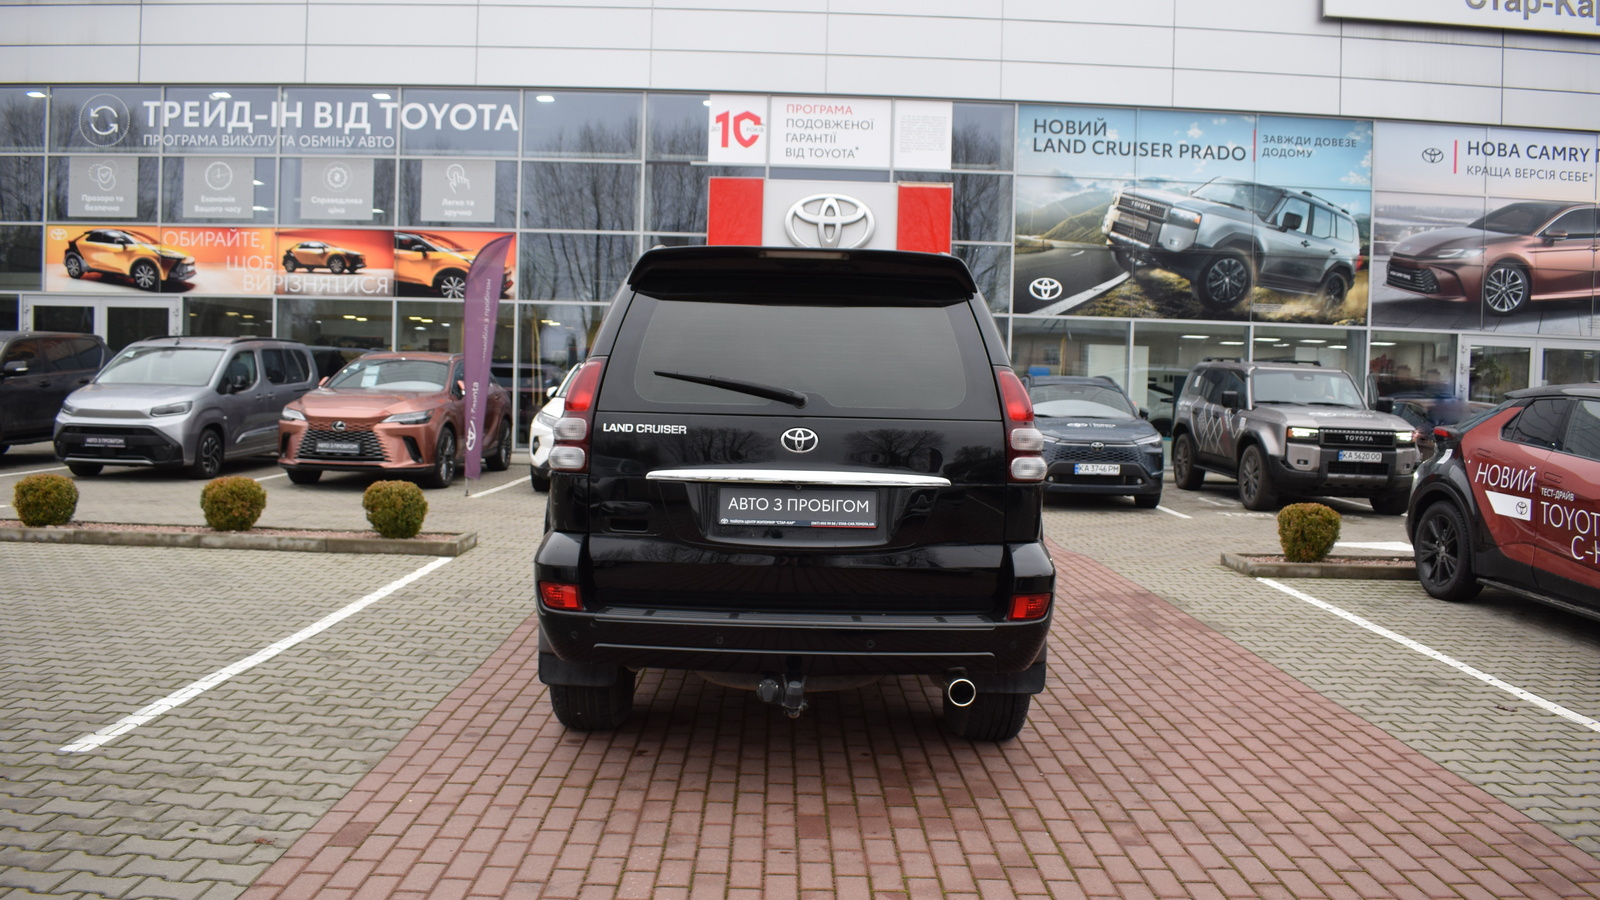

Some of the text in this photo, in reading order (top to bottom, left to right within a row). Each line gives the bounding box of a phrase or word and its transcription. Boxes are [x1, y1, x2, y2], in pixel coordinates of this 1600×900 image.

[1465, 0, 1600, 26] ар-Ка
[143, 97, 519, 135] ТРЕЙД-ІН ВІД TOYOTA
[786, 103, 853, 115] ПРОГРАМА
[786, 118, 875, 131] ПОДОВЖЕНОЇ
[1034, 117, 1107, 137] НОВИЙ
[143, 134, 395, 148] ПРОГРАМА ВИКУПУ ТА ОБМІНУ АВТО
[785, 131, 838, 144] ГАРАНТІЇ
[1263, 134, 1357, 148] ЗАВЖДИ ДОВЕЗЕ
[785, 147, 805, 159] ВІД
[1033, 137, 1246, 161] LAND CRUISER PRADO
[1262, 148, 1313, 159] ДОДОМУ
[1467, 141, 1521, 158] НОВА
[1526, 144, 1590, 162] CAMRY
[1466, 165, 1511, 179] КРАЩА
[1515, 168, 1556, 180] ВЕРСІЯ
[82, 194, 114, 203] Прозоро
[163, 228, 266, 249] ОБИРАЙТЕ,
[226, 255, 274, 273] ЩОБ
[244, 274, 389, 295] ВИРІЗНЯТИСЯ
[602, 422, 687, 435] LAND CRUISER
[1354, 452, 1370, 460] 5620
[1474, 462, 1536, 493] НОВИЙ
[1541, 487, 1575, 501] ТЕСТ-ДРАЙВ
[728, 497, 769, 511] АВТО
[787, 498, 869, 513] ПРОБІГОМ
